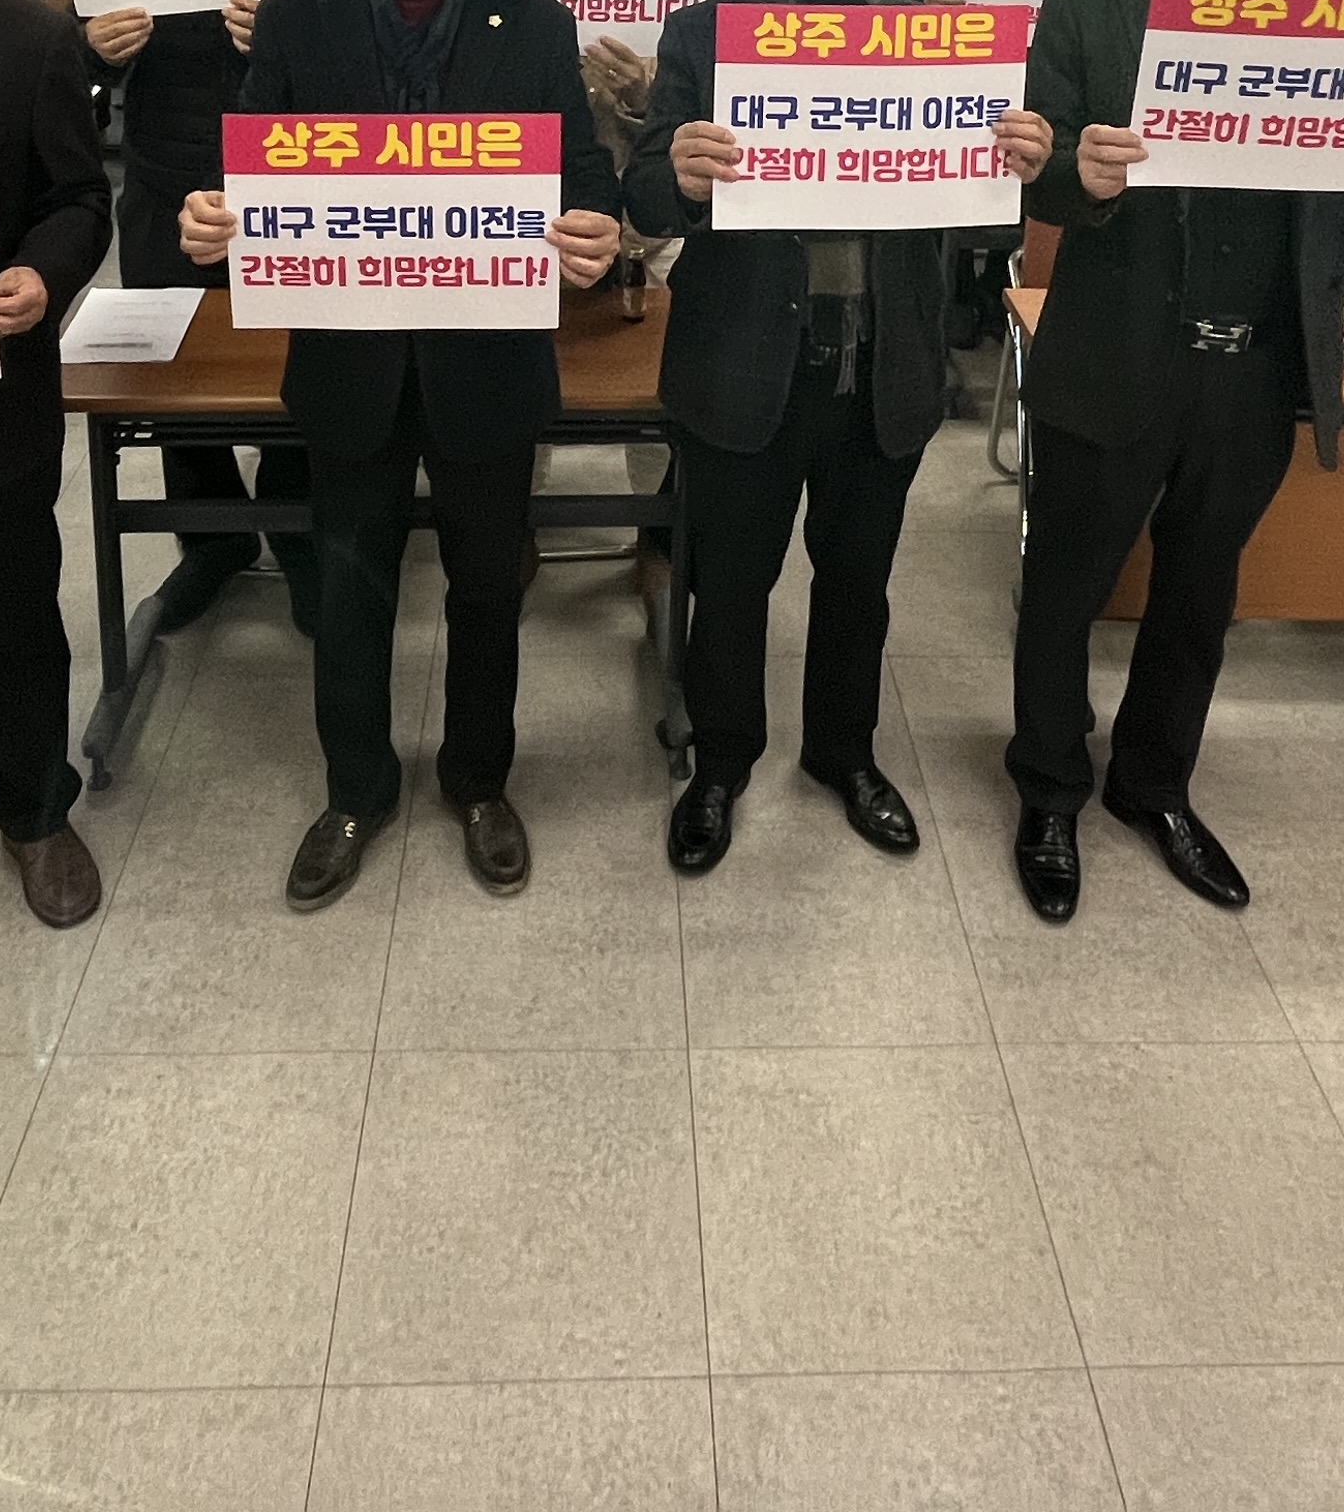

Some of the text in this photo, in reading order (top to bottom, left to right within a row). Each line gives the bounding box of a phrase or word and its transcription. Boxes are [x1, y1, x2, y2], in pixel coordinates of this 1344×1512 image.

[754, 12, 846, 58] 상주
[860, 12, 995, 59] 시민은
[1156, 60, 1228, 95] 대구
[731, 95, 1011, 131] 대구 군부대 이전을
[1142, 109, 1250, 145] 간절히
[262, 121, 523, 168] 상주 시민은
[736, 147, 825, 182] 간절히
[243, 206, 546, 240] 대구 군부대 이전을
[240, 256, 549, 288] 간절히 희망합니다!
